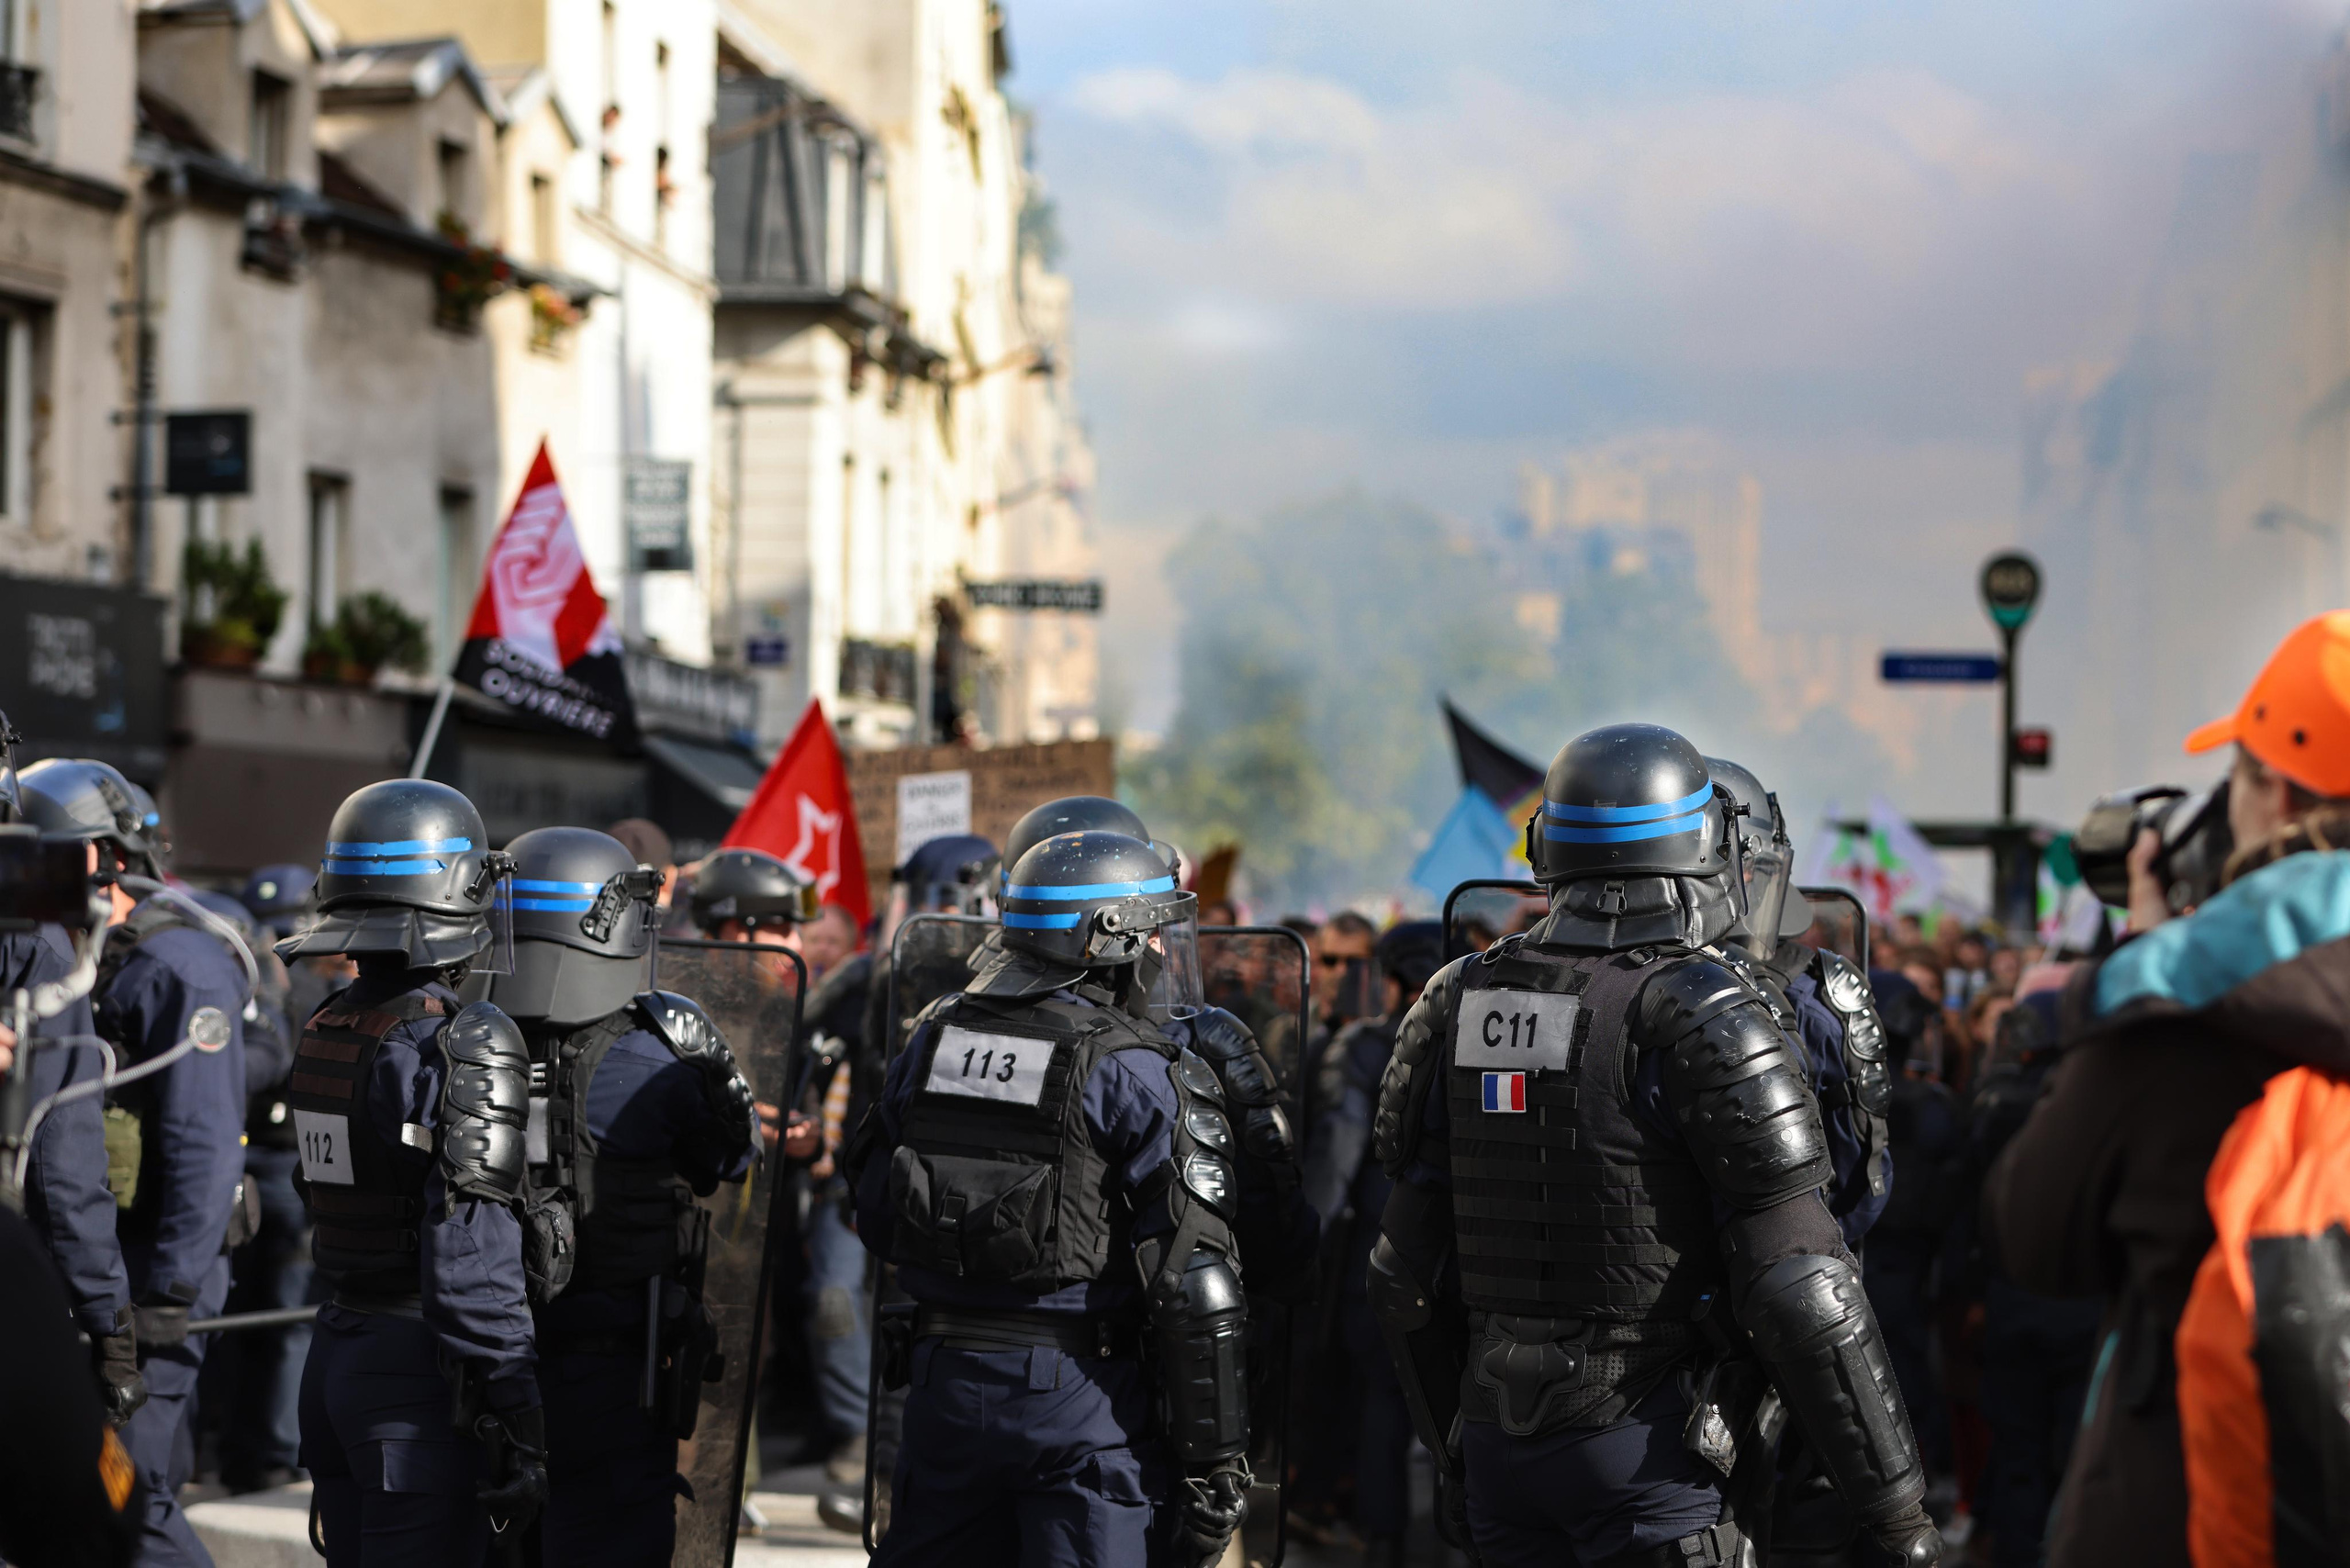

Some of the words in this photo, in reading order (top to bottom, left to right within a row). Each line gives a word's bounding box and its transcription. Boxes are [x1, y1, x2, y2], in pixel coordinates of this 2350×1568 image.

[1482, 1010, 1539, 1048] C11
[962, 1047, 1017, 1082] 113
[306, 1130, 334, 1164] 112
